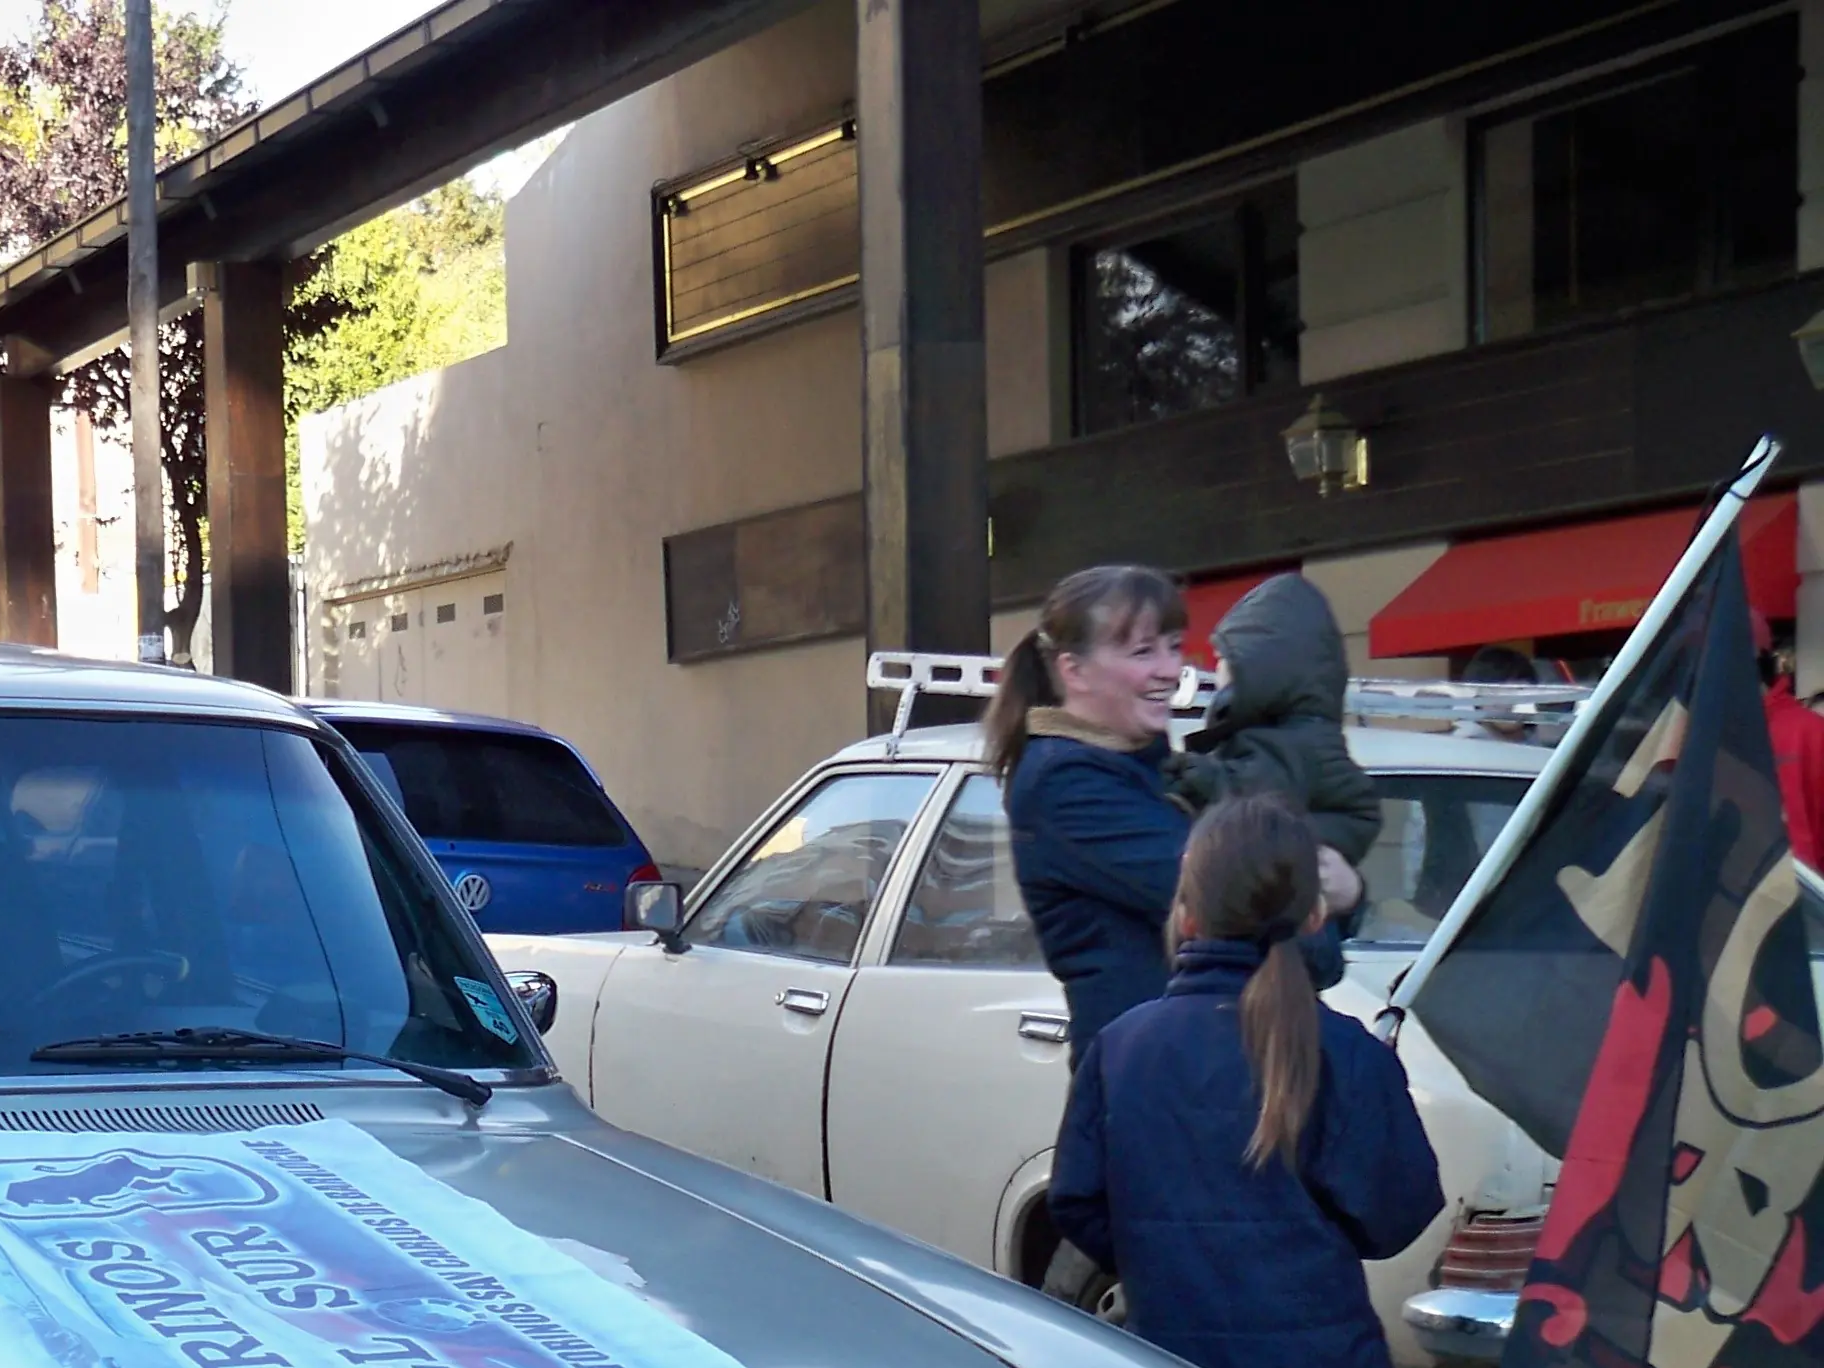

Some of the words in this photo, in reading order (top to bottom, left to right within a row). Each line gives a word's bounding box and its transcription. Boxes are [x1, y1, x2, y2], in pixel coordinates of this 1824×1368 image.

[240, 1140, 373, 1200] BARILOCHE
[335, 1201, 398, 1216] DE
[190, 1225, 360, 1309] SUR
[363, 1217, 471, 1269] CARLOS
